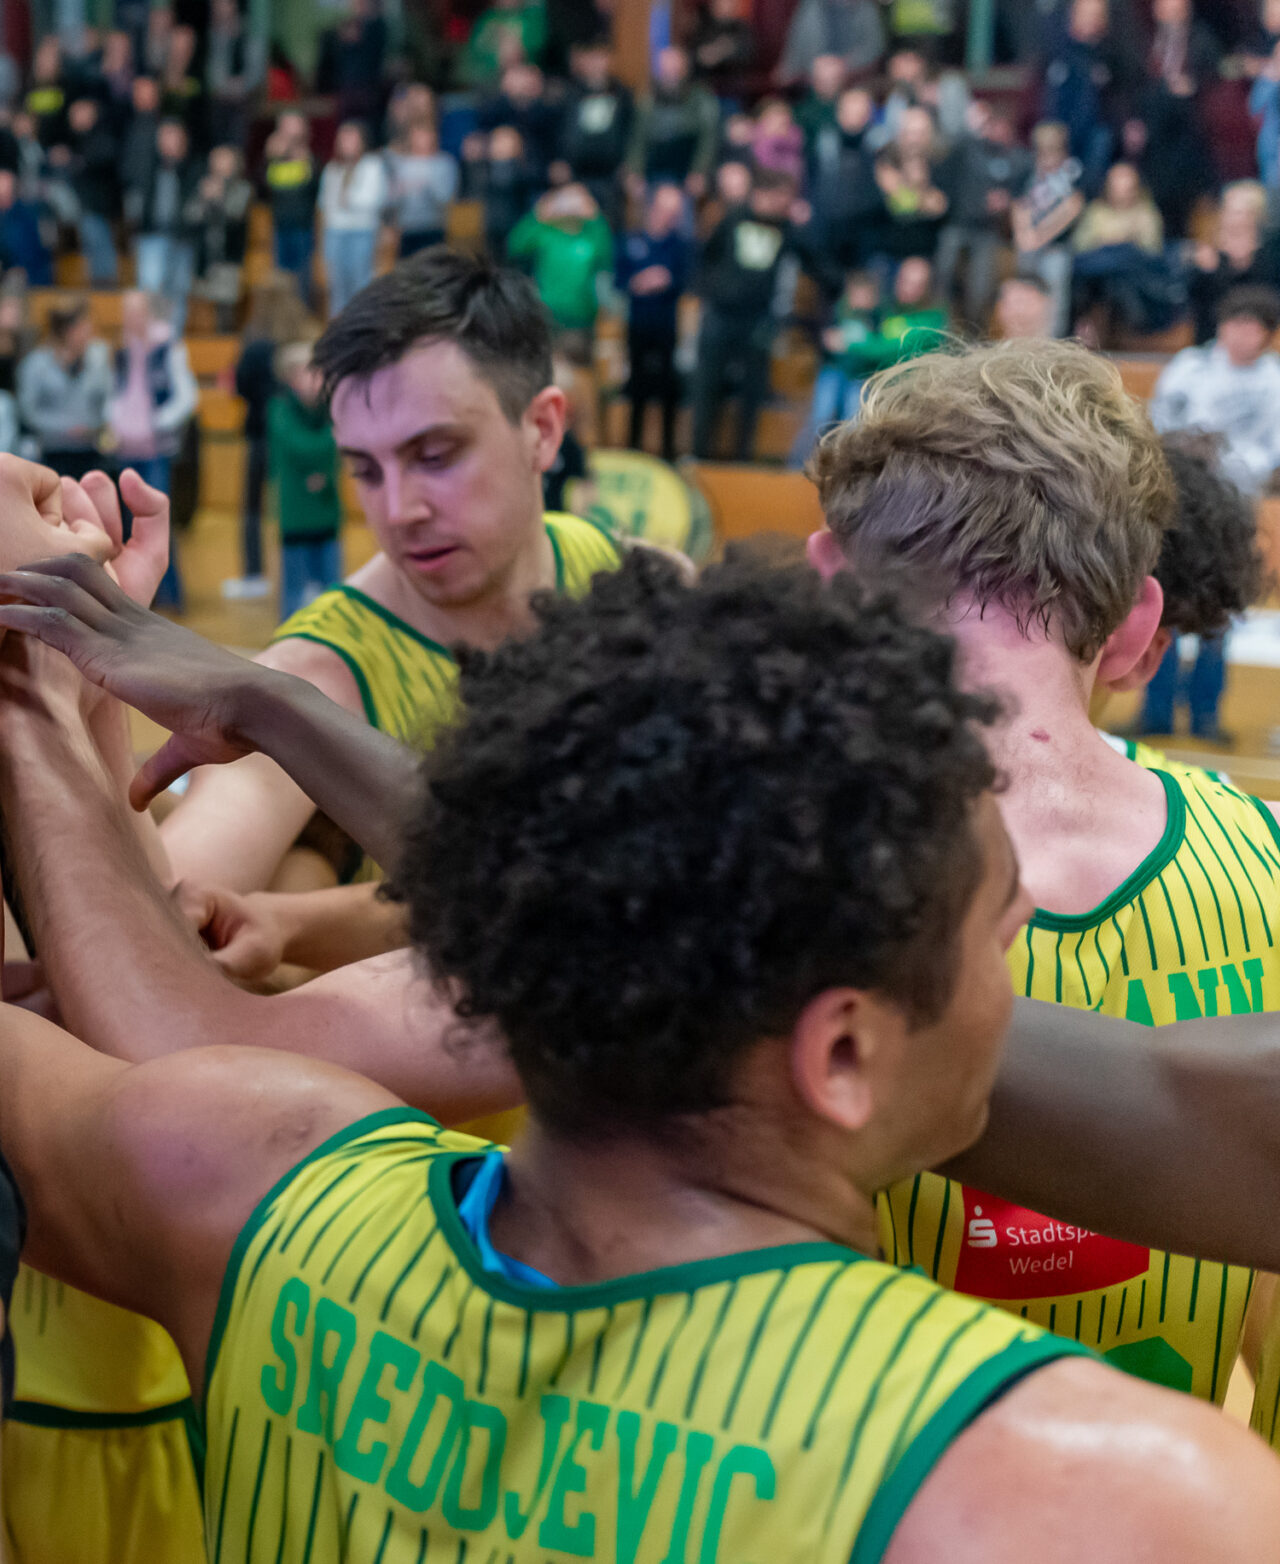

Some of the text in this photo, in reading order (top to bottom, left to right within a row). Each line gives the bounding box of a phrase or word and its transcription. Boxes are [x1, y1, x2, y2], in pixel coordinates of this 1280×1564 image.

[1092, 958, 1264, 1027] ANN
[1006, 1221, 1099, 1245] Stadtsp
[1009, 1250, 1073, 1276] Wedel
[261, 1277, 776, 1564] SREDOJEVIC
